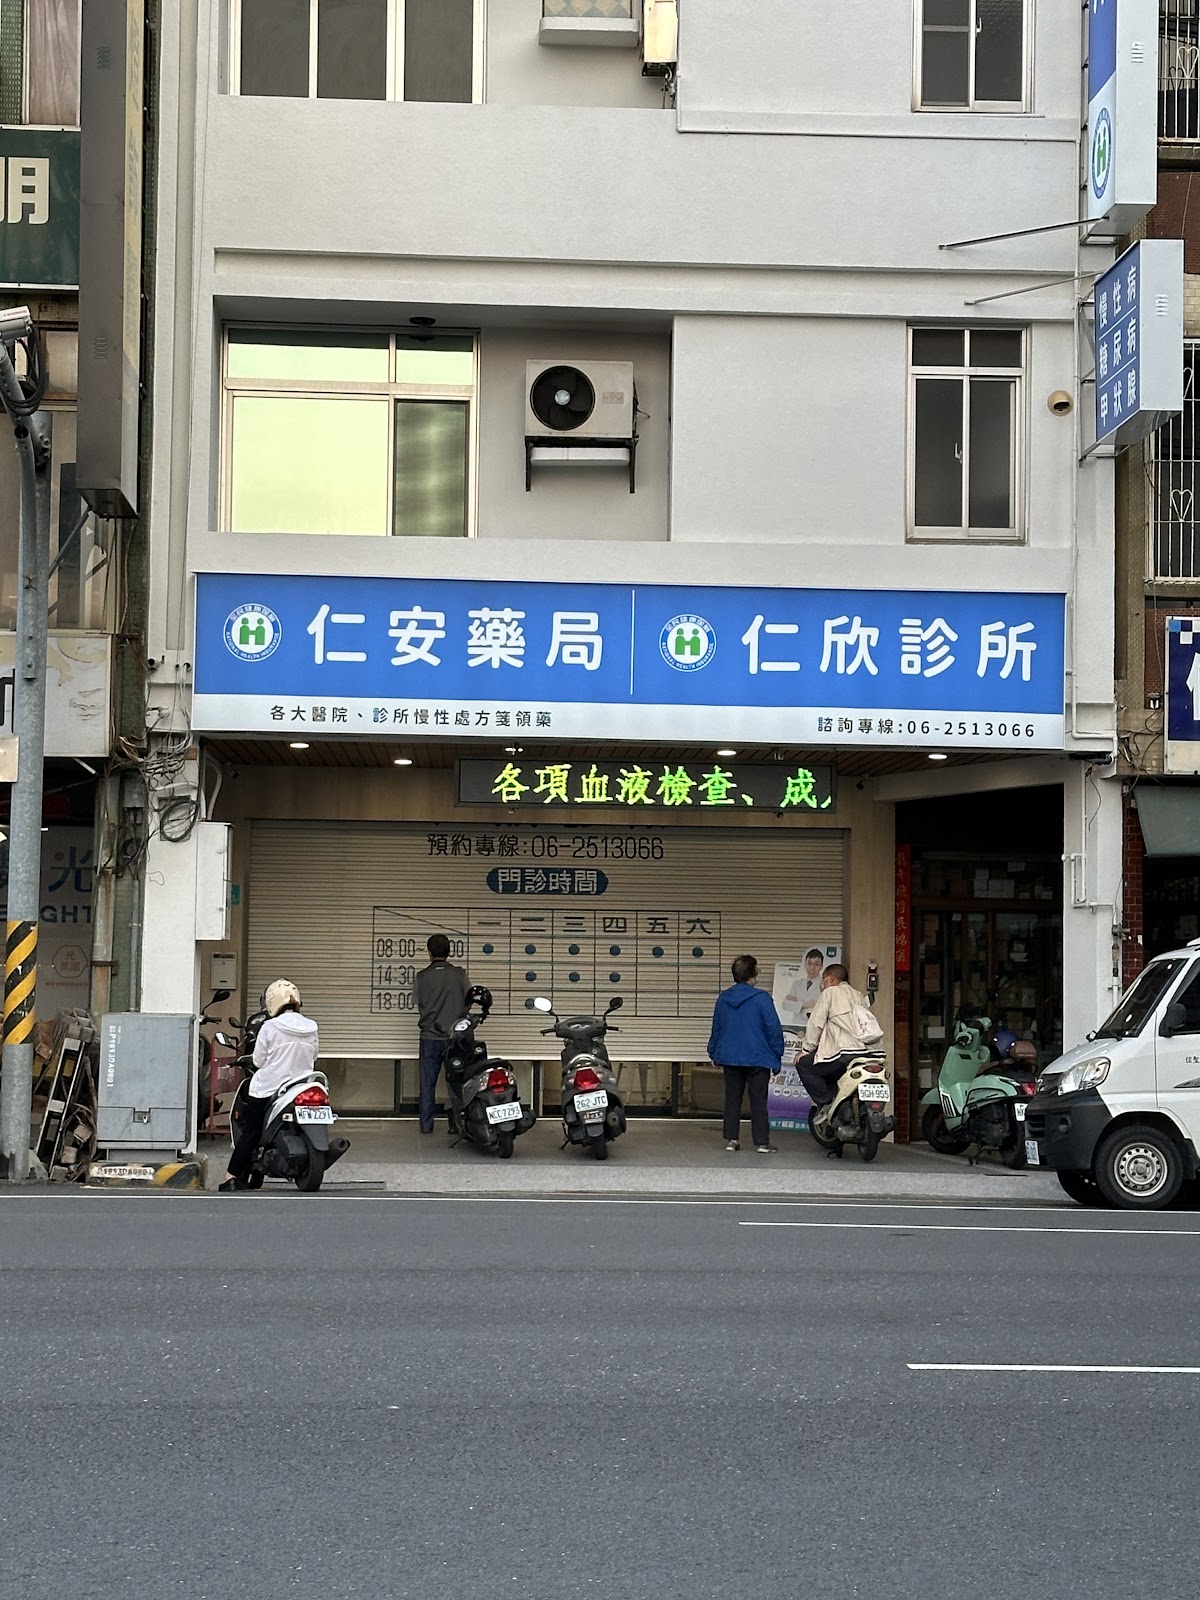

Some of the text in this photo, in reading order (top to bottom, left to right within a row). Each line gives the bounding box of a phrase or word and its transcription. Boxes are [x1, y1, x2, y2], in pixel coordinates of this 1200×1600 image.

[1099, 265, 1137, 330] 慢性病
[1099, 316, 1137, 380] 糖尿病
[1100, 368, 1137, 427] 甲狀腺
[307, 604, 603, 671] 仁安藥局
[741, 614, 1037, 681] 仁欣診所
[270, 705, 552, 728] 各大醫院、診所慢性處方箋領藥
[492, 762, 832, 808] 各項血液檢查、成
[498, 868, 598, 894] 門診時間
[520, 917, 546, 932] 二
[563, 917, 587, 932] 三
[603, 917, 627, 933] 四
[647, 917, 670, 934] 五
[687, 917, 713, 935] 六
